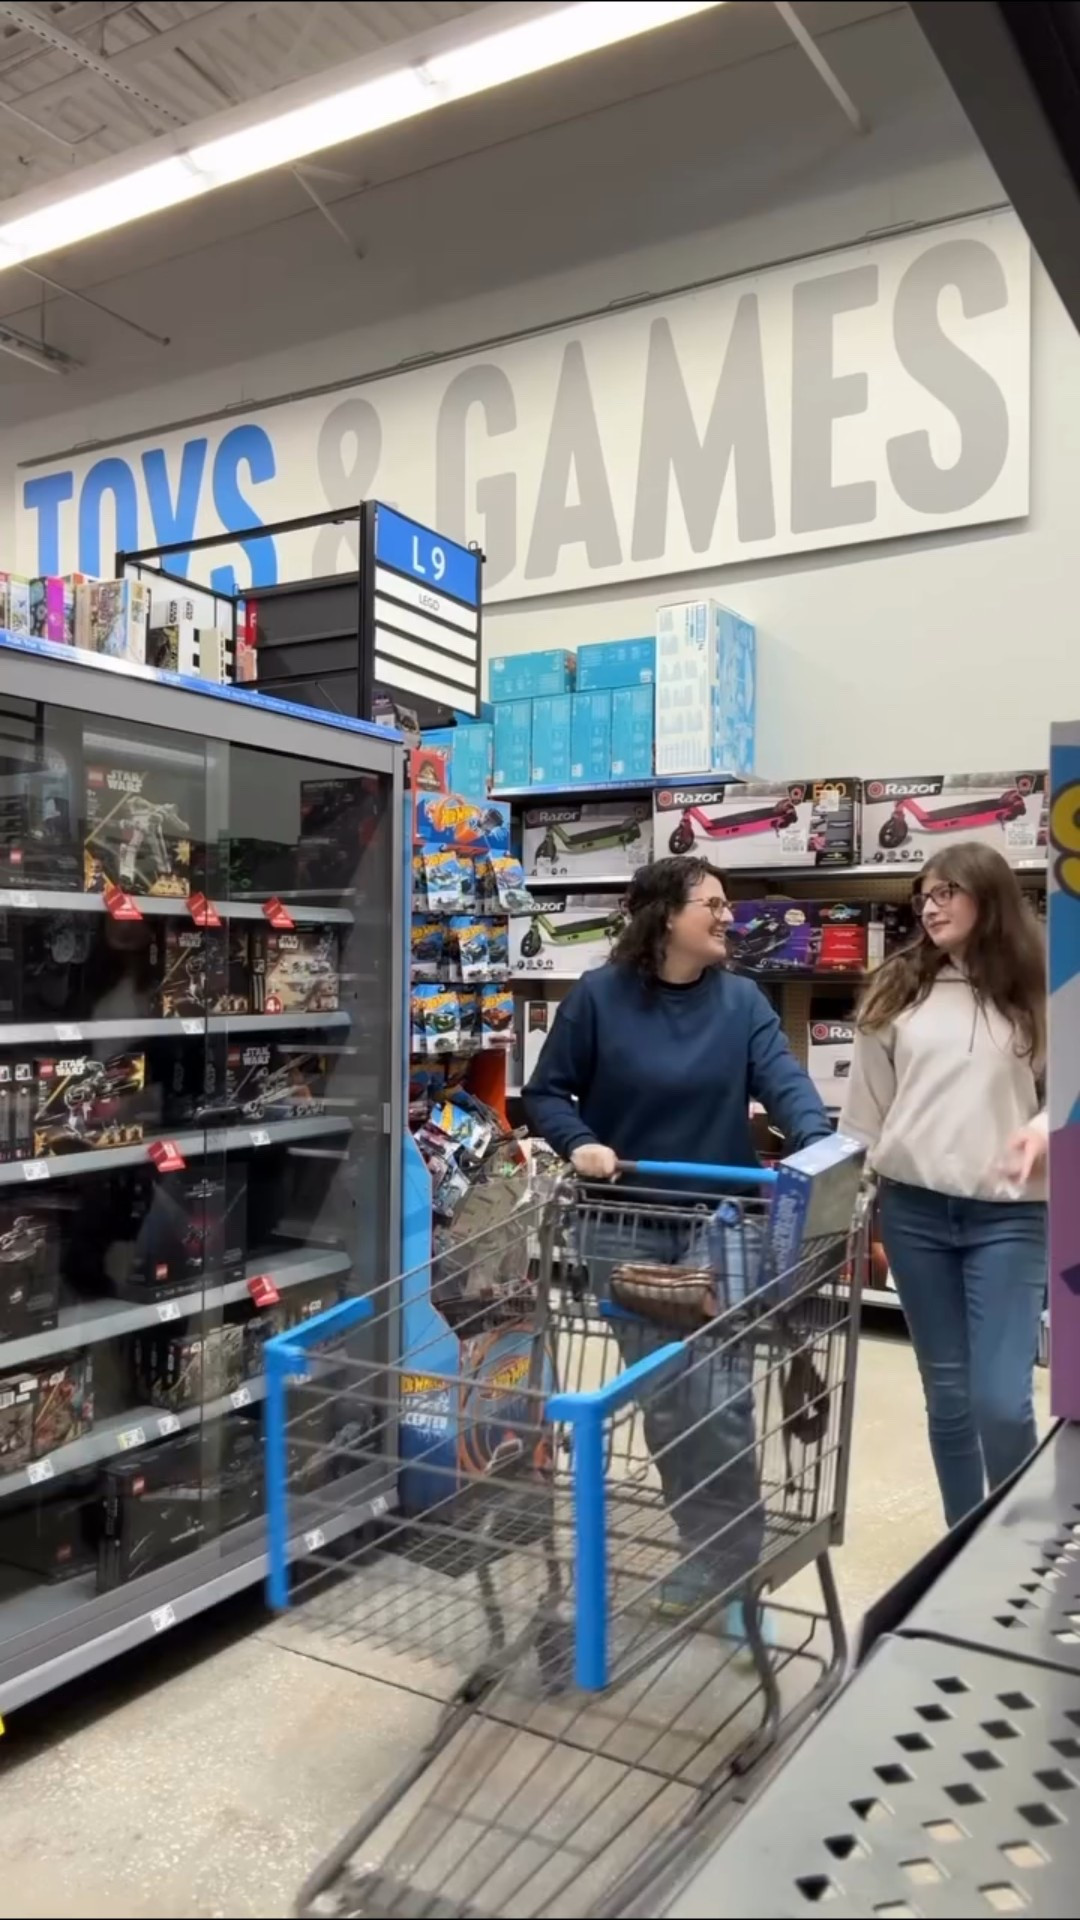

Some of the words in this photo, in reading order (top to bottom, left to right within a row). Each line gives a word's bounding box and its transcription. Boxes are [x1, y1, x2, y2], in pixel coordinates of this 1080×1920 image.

[23, 424, 278, 600] TOYS
[436, 238, 1010, 592] GAMES
[412, 535, 426, 574] L
[431, 546, 446, 581] 9
[885, 783, 941, 796] Razor
[673, 792, 722, 805] Razor
[538, 809, 579, 823] Razor
